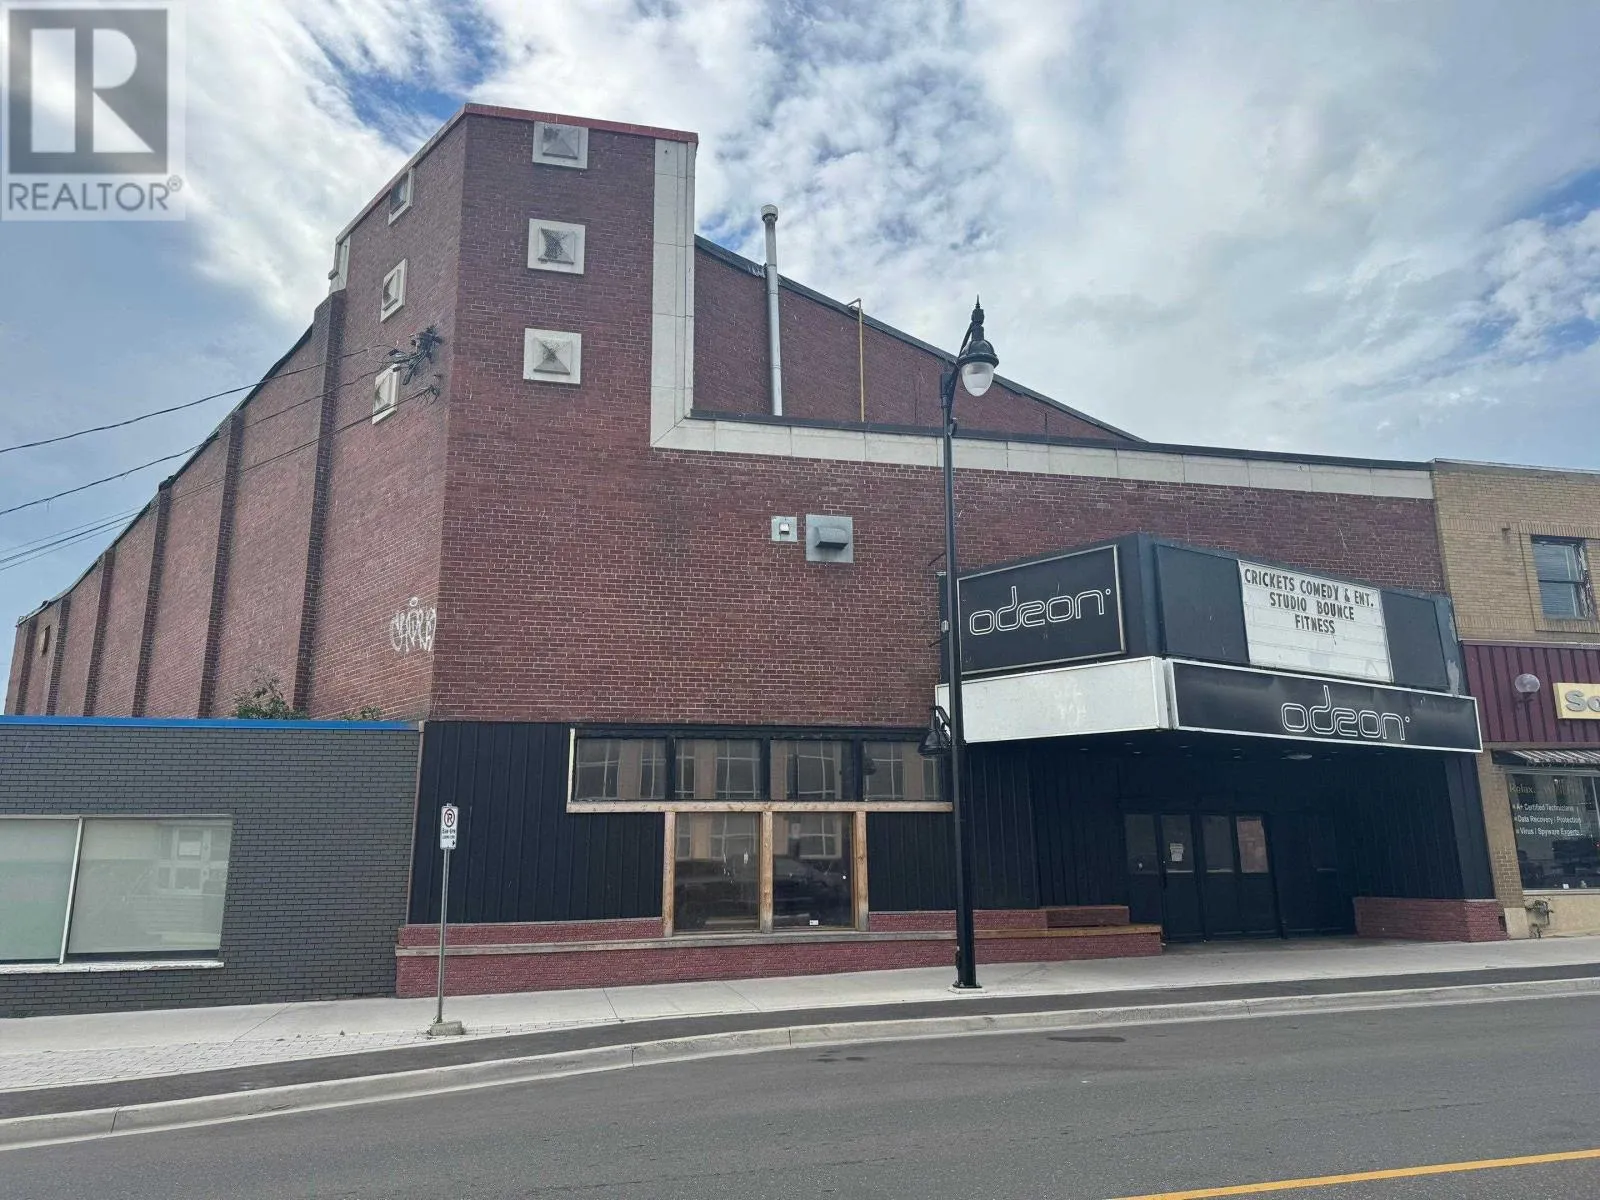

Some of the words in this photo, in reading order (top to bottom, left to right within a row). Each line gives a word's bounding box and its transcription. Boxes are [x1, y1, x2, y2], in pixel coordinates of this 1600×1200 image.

[1244, 568, 1295, 592] CRICKETS
[1300, 579, 1340, 601] COMEDY
[1344, 588, 1351, 603] &
[1269, 592, 1307, 612] STUDIO
[1317, 600, 1355, 621] BOUNCE
[1294, 614, 1336, 634] FITNESS
[1530, 816, 1553, 824] Recovery
[1556, 816, 1581, 824] Protection
[1537, 827, 1560, 836] Spyware
